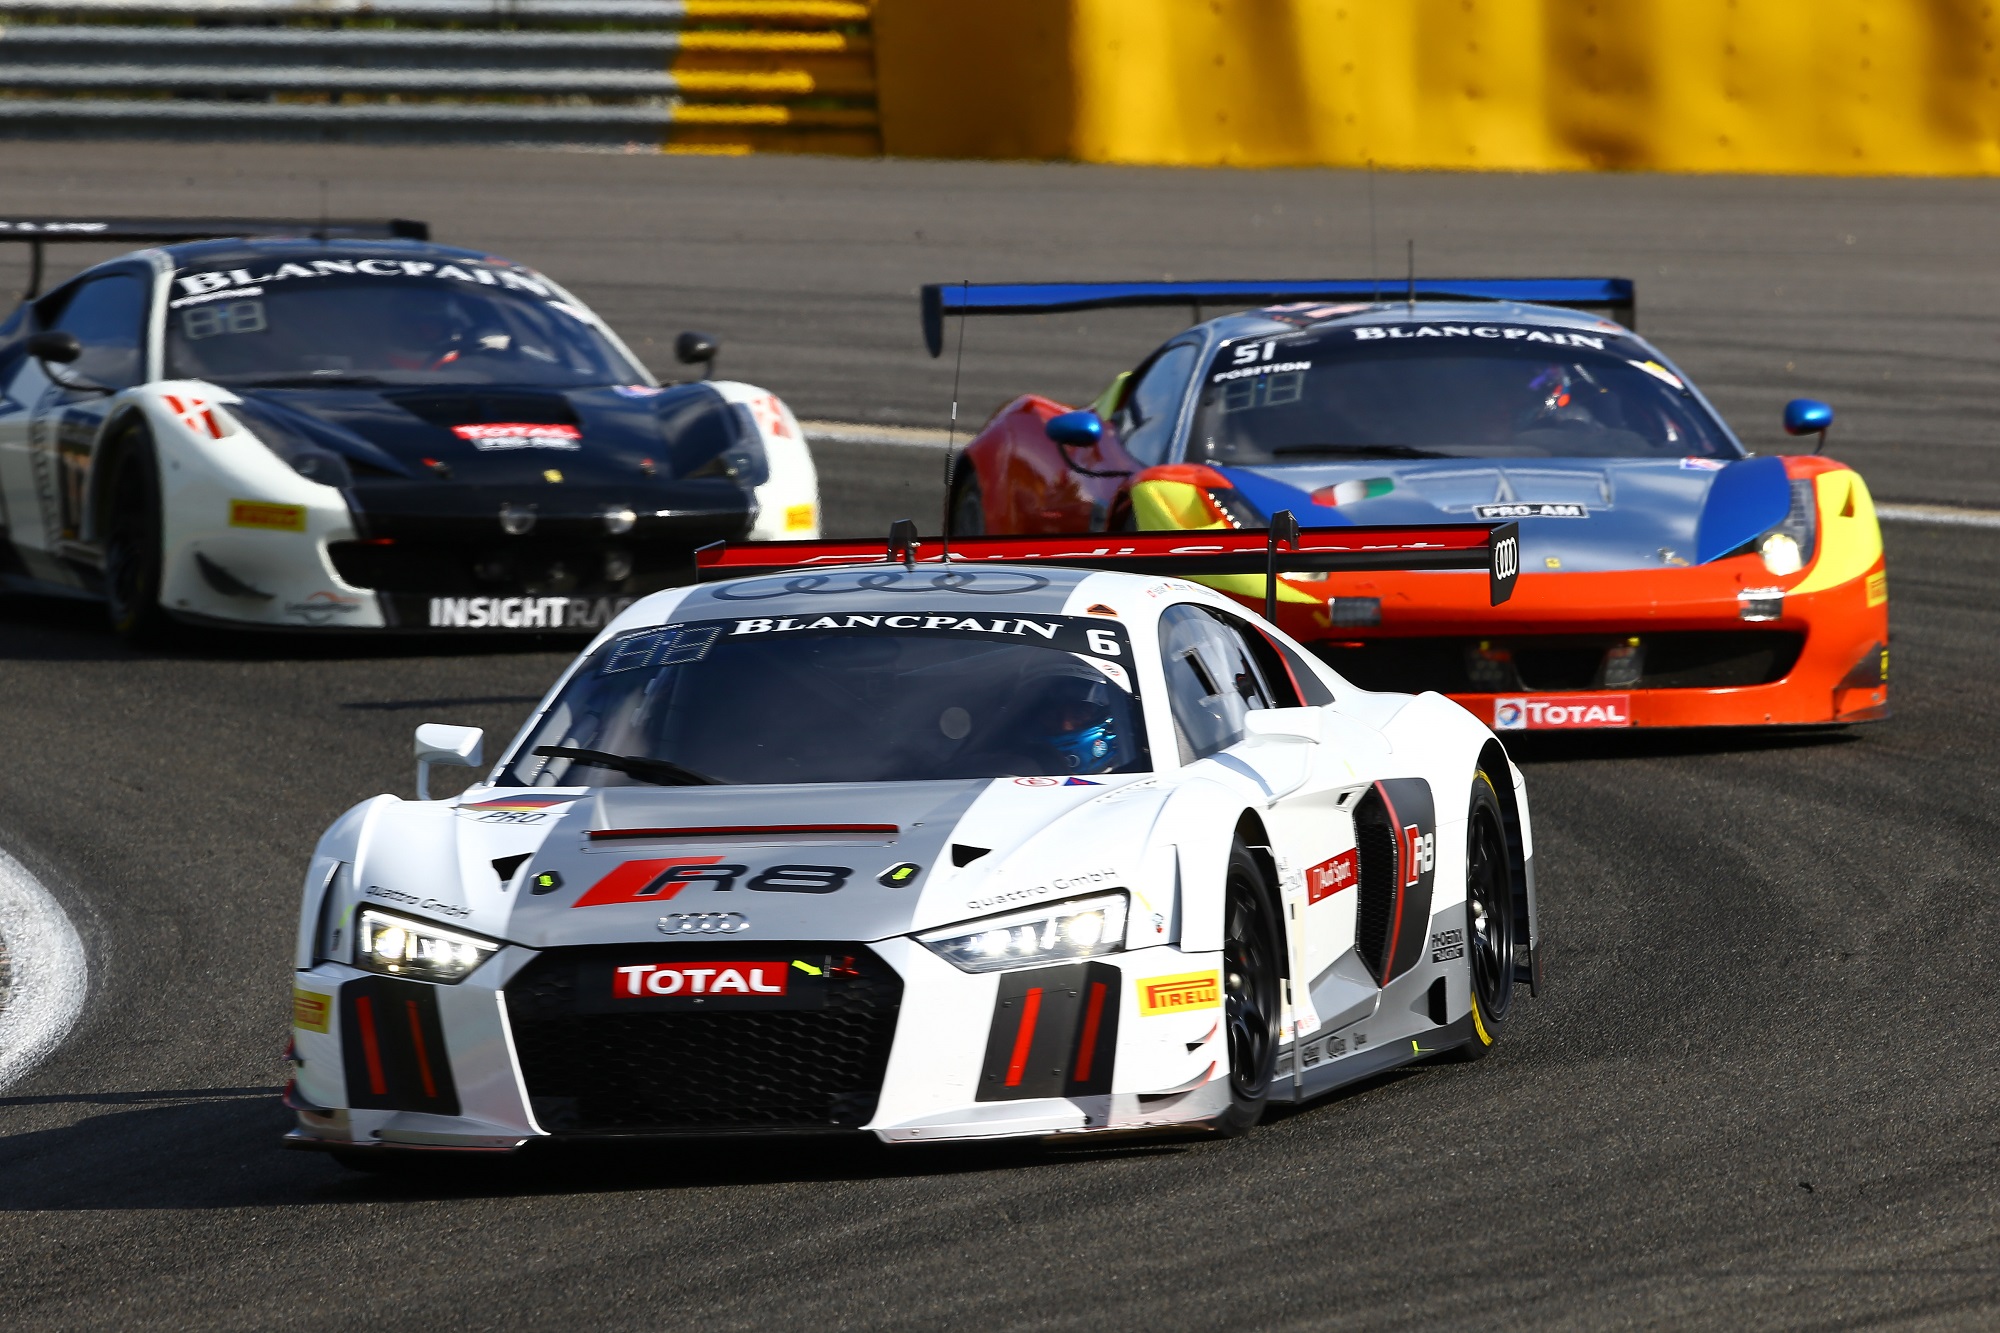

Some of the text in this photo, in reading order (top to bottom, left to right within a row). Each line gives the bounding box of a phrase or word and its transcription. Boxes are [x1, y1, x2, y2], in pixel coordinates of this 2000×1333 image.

[176, 257, 549, 297] BLANCPAIN
[1352, 326, 1605, 350] BLANCPAIN
[1232, 341, 1276, 365] 51
[1213, 360, 1312, 383] POSITION
[1482, 504, 1580, 517] PRO-AM
[728, 614, 1063, 640] BLANCPAIN
[1085, 629, 1121, 656] 6
[1526, 702, 1626, 725] TOTAL
[478, 811, 548, 823] PRO
[633, 863, 855, 895] R8
[966, 867, 1121, 911] quattro GmbH
[364, 885, 475, 920] quattro GmbH
[617, 964, 782, 996] TOTAL
[1146, 978, 1216, 1009] PIRELLI
